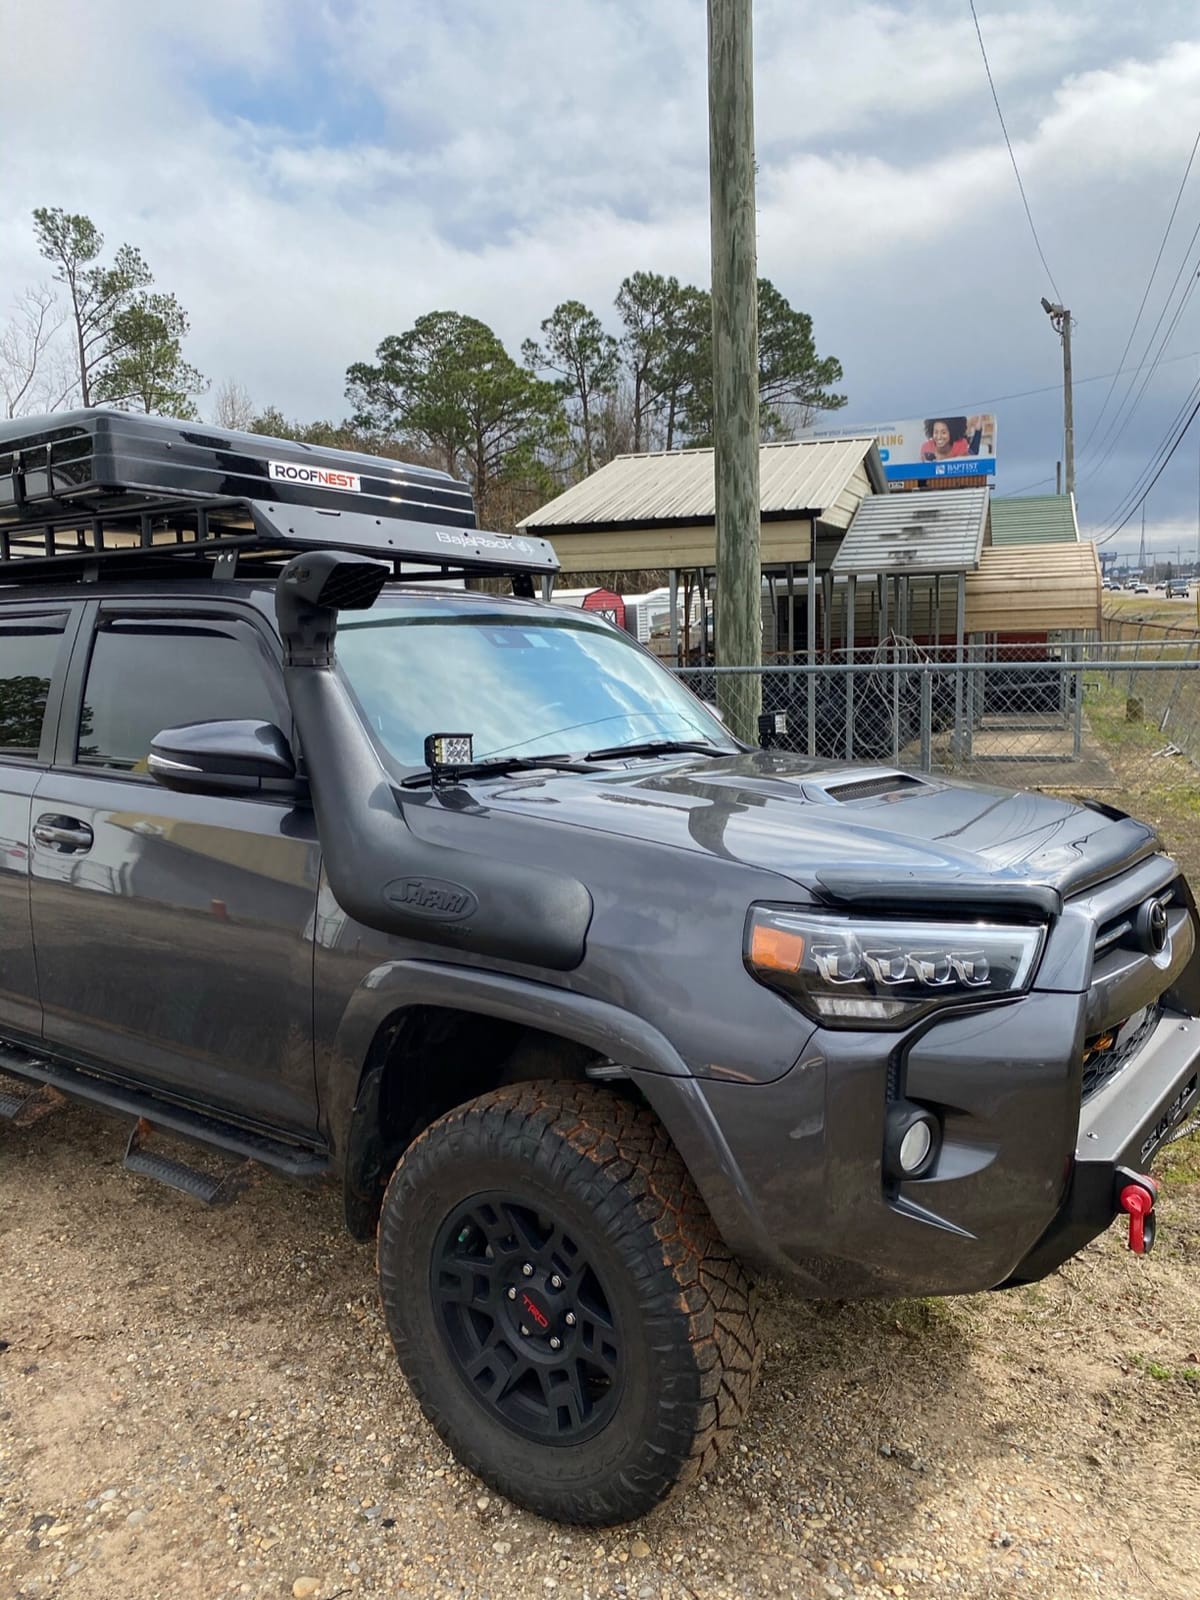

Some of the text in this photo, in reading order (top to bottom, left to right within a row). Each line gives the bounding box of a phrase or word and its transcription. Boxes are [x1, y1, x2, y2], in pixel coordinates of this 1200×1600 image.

[275, 465, 355, 488] ROOFNEST
[947, 462, 978, 471] BAPTIST
[436, 531, 515, 550] BajaRack
[522, 1293, 548, 1328] TRD
